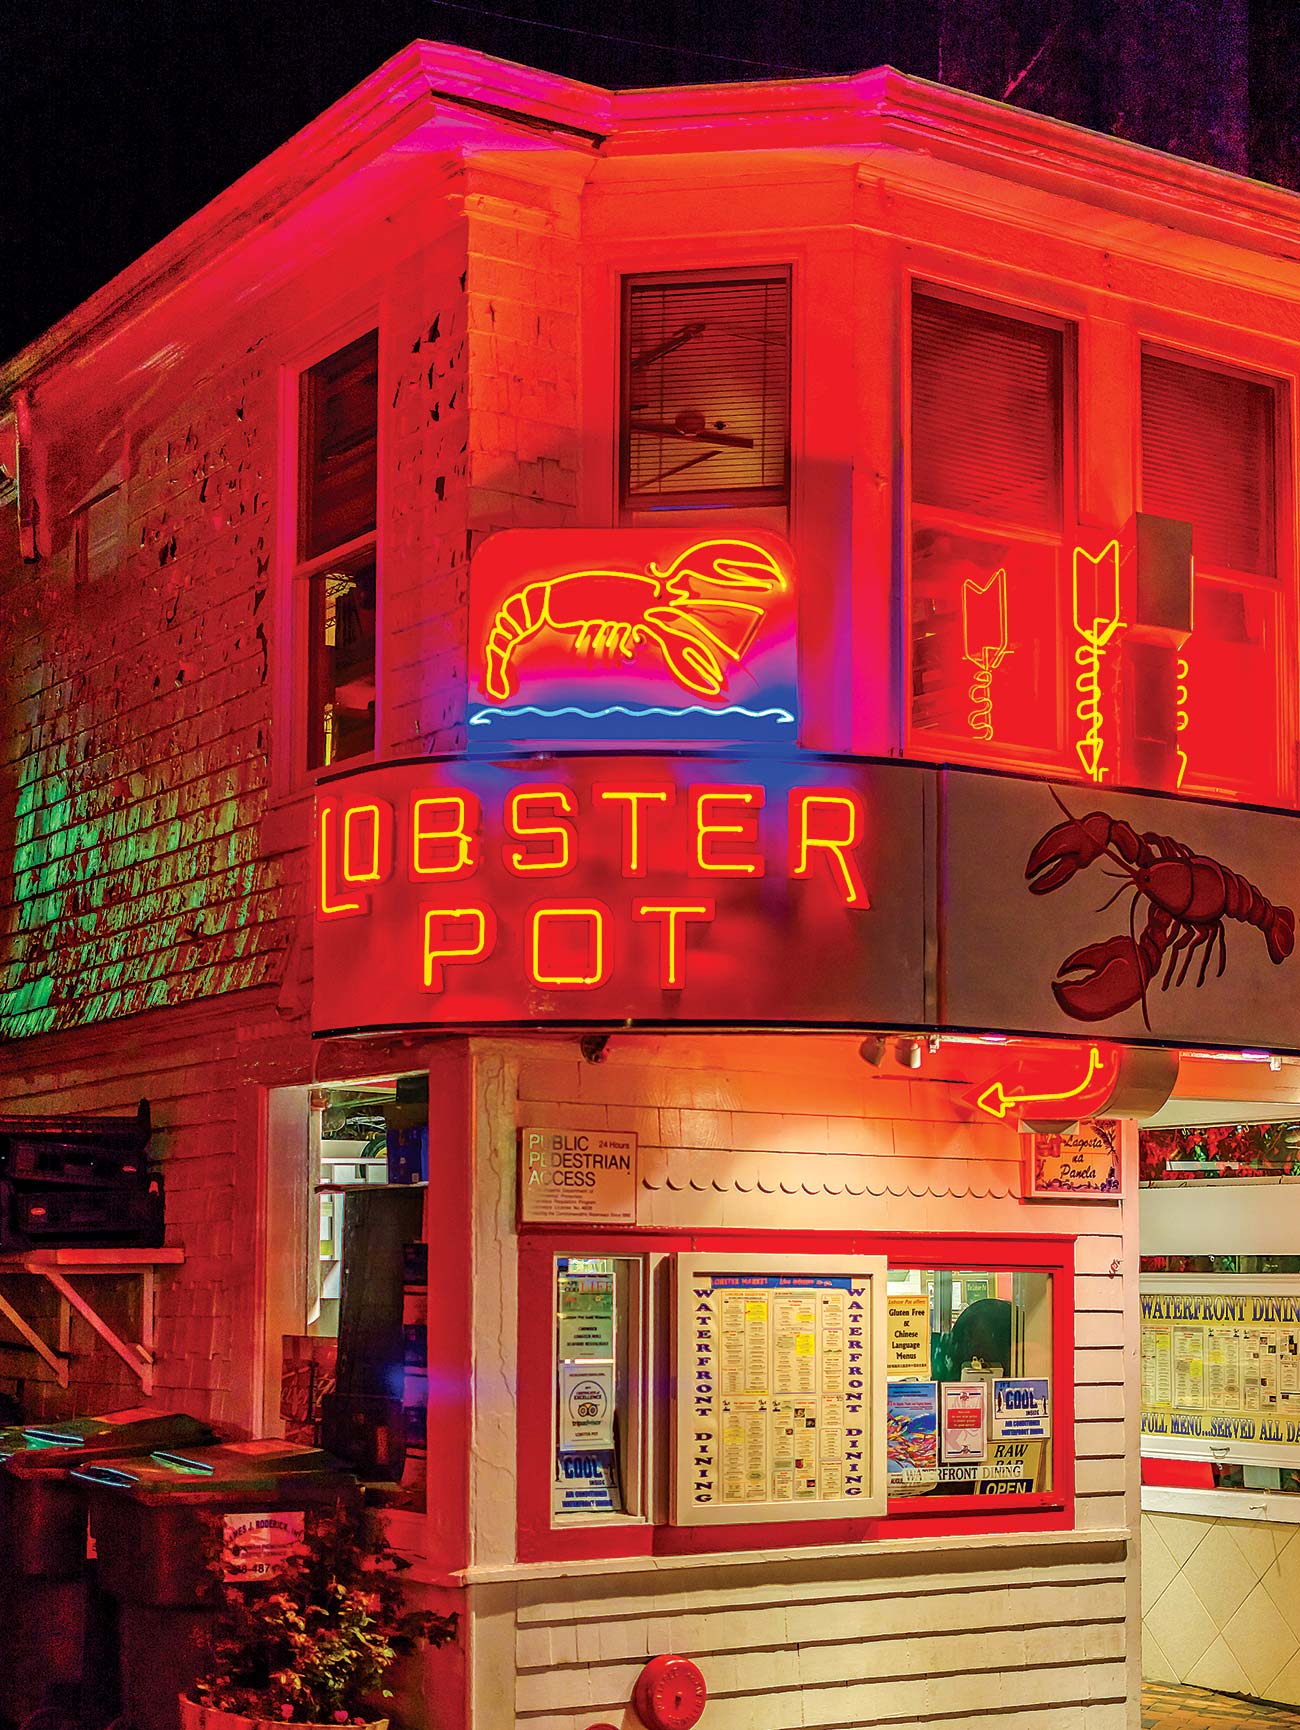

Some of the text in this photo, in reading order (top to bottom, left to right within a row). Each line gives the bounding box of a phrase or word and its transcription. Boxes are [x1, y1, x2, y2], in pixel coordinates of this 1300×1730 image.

[316, 783, 870, 922] LOBSTER
[419, 896, 715, 993] POT
[598, 1140, 608, 1149] 24
[609, 1140, 630, 1149] Hours
[528, 1170, 596, 1187] ACCESS
[888, 1308, 925, 1317] Gluten Free
[1141, 1295, 1247, 1321] WATERFRONT
[894, 1330, 918, 1338] Chinese
[693, 1289, 714, 1417] WATERFRONT
[845, 1288, 866, 1413] WATERFRONT
[891, 1341, 920, 1350] Language
[896, 1352, 917, 1360] Menus
[1005, 1389, 1039, 1410] COOL
[1141, 1412, 1168, 1433] FULL
[1259, 1419, 1283, 1442] ALL
[994, 1444, 1029, 1458] RAW
[563, 1456, 603, 1479] COOL
[694, 1432, 714, 1503] DINING
[844, 1428, 863, 1496] DINING
[904, 1467, 979, 1482] WARFRONT
[982, 1465, 1021, 1479] DINING
[985, 1482, 1027, 1495] OPEN
